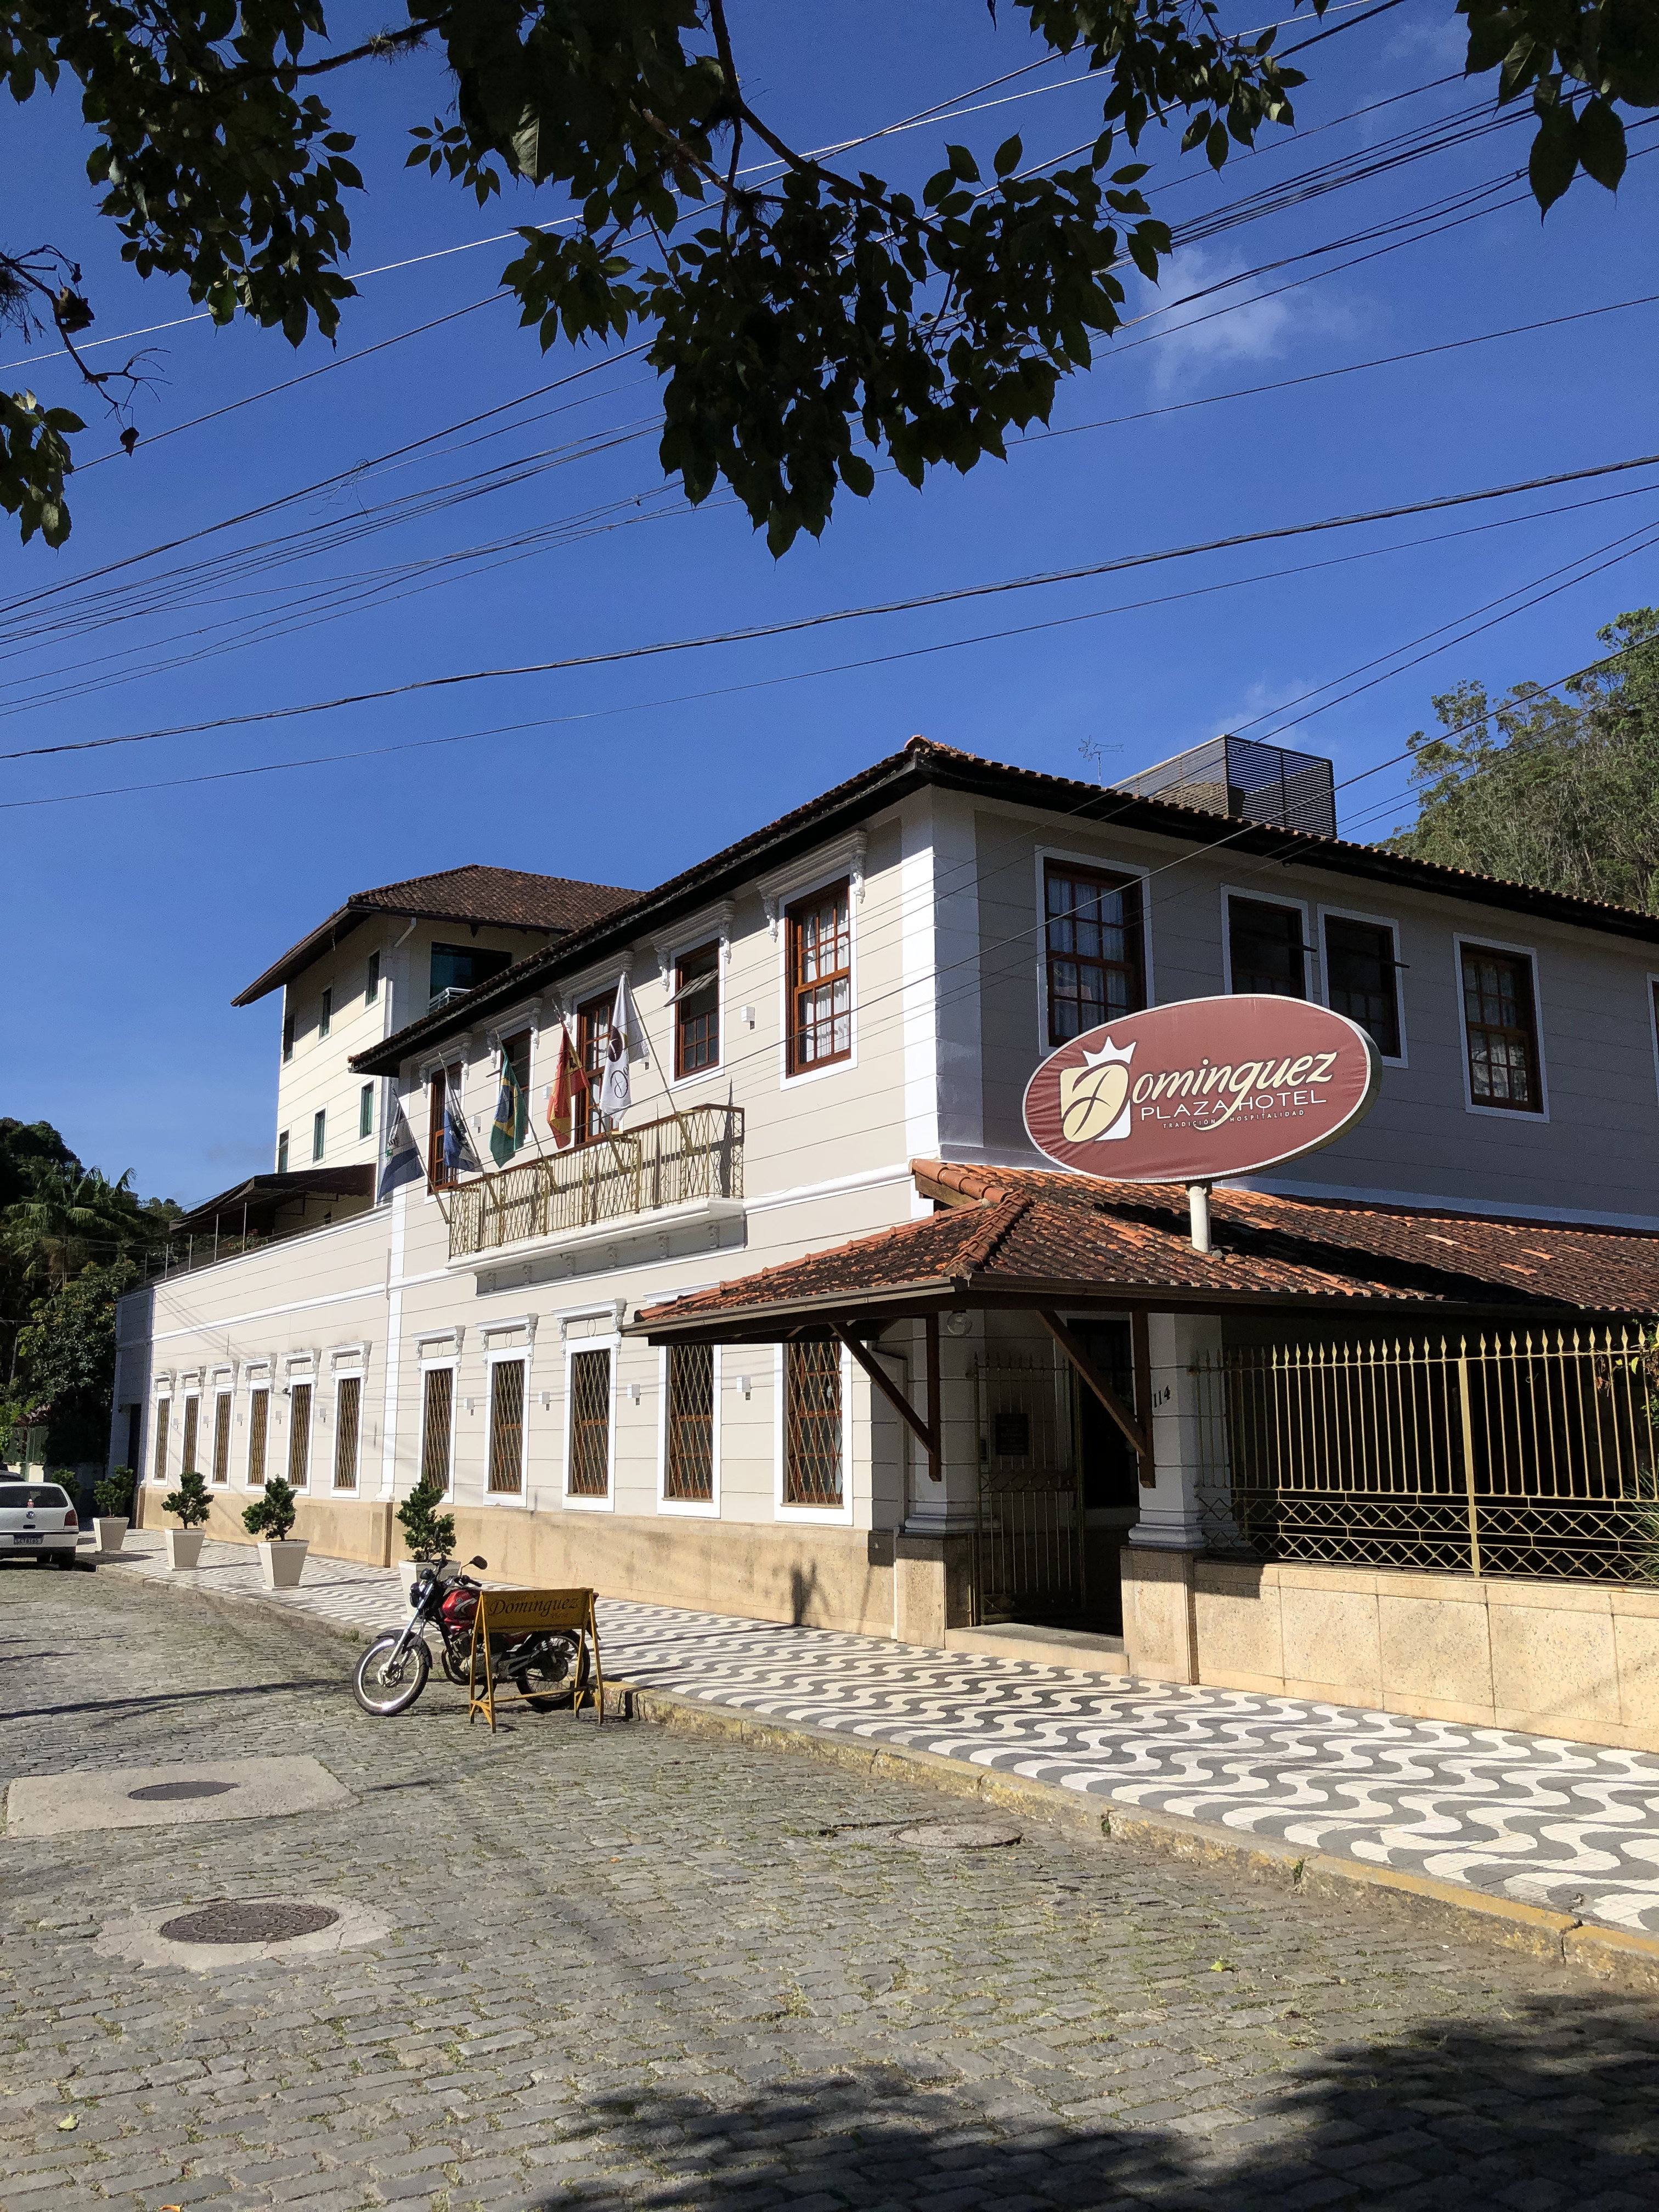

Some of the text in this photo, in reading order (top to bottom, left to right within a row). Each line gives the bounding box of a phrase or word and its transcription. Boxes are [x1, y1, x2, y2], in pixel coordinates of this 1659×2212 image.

[1142, 1090, 1327, 1121] PLAZA HOTEL
[1230, 1110, 1304, 1122] HOSPITALIDAD
[1153, 1385, 1171, 1408] 114
[488, 1596, 579, 1617] Dominguez
